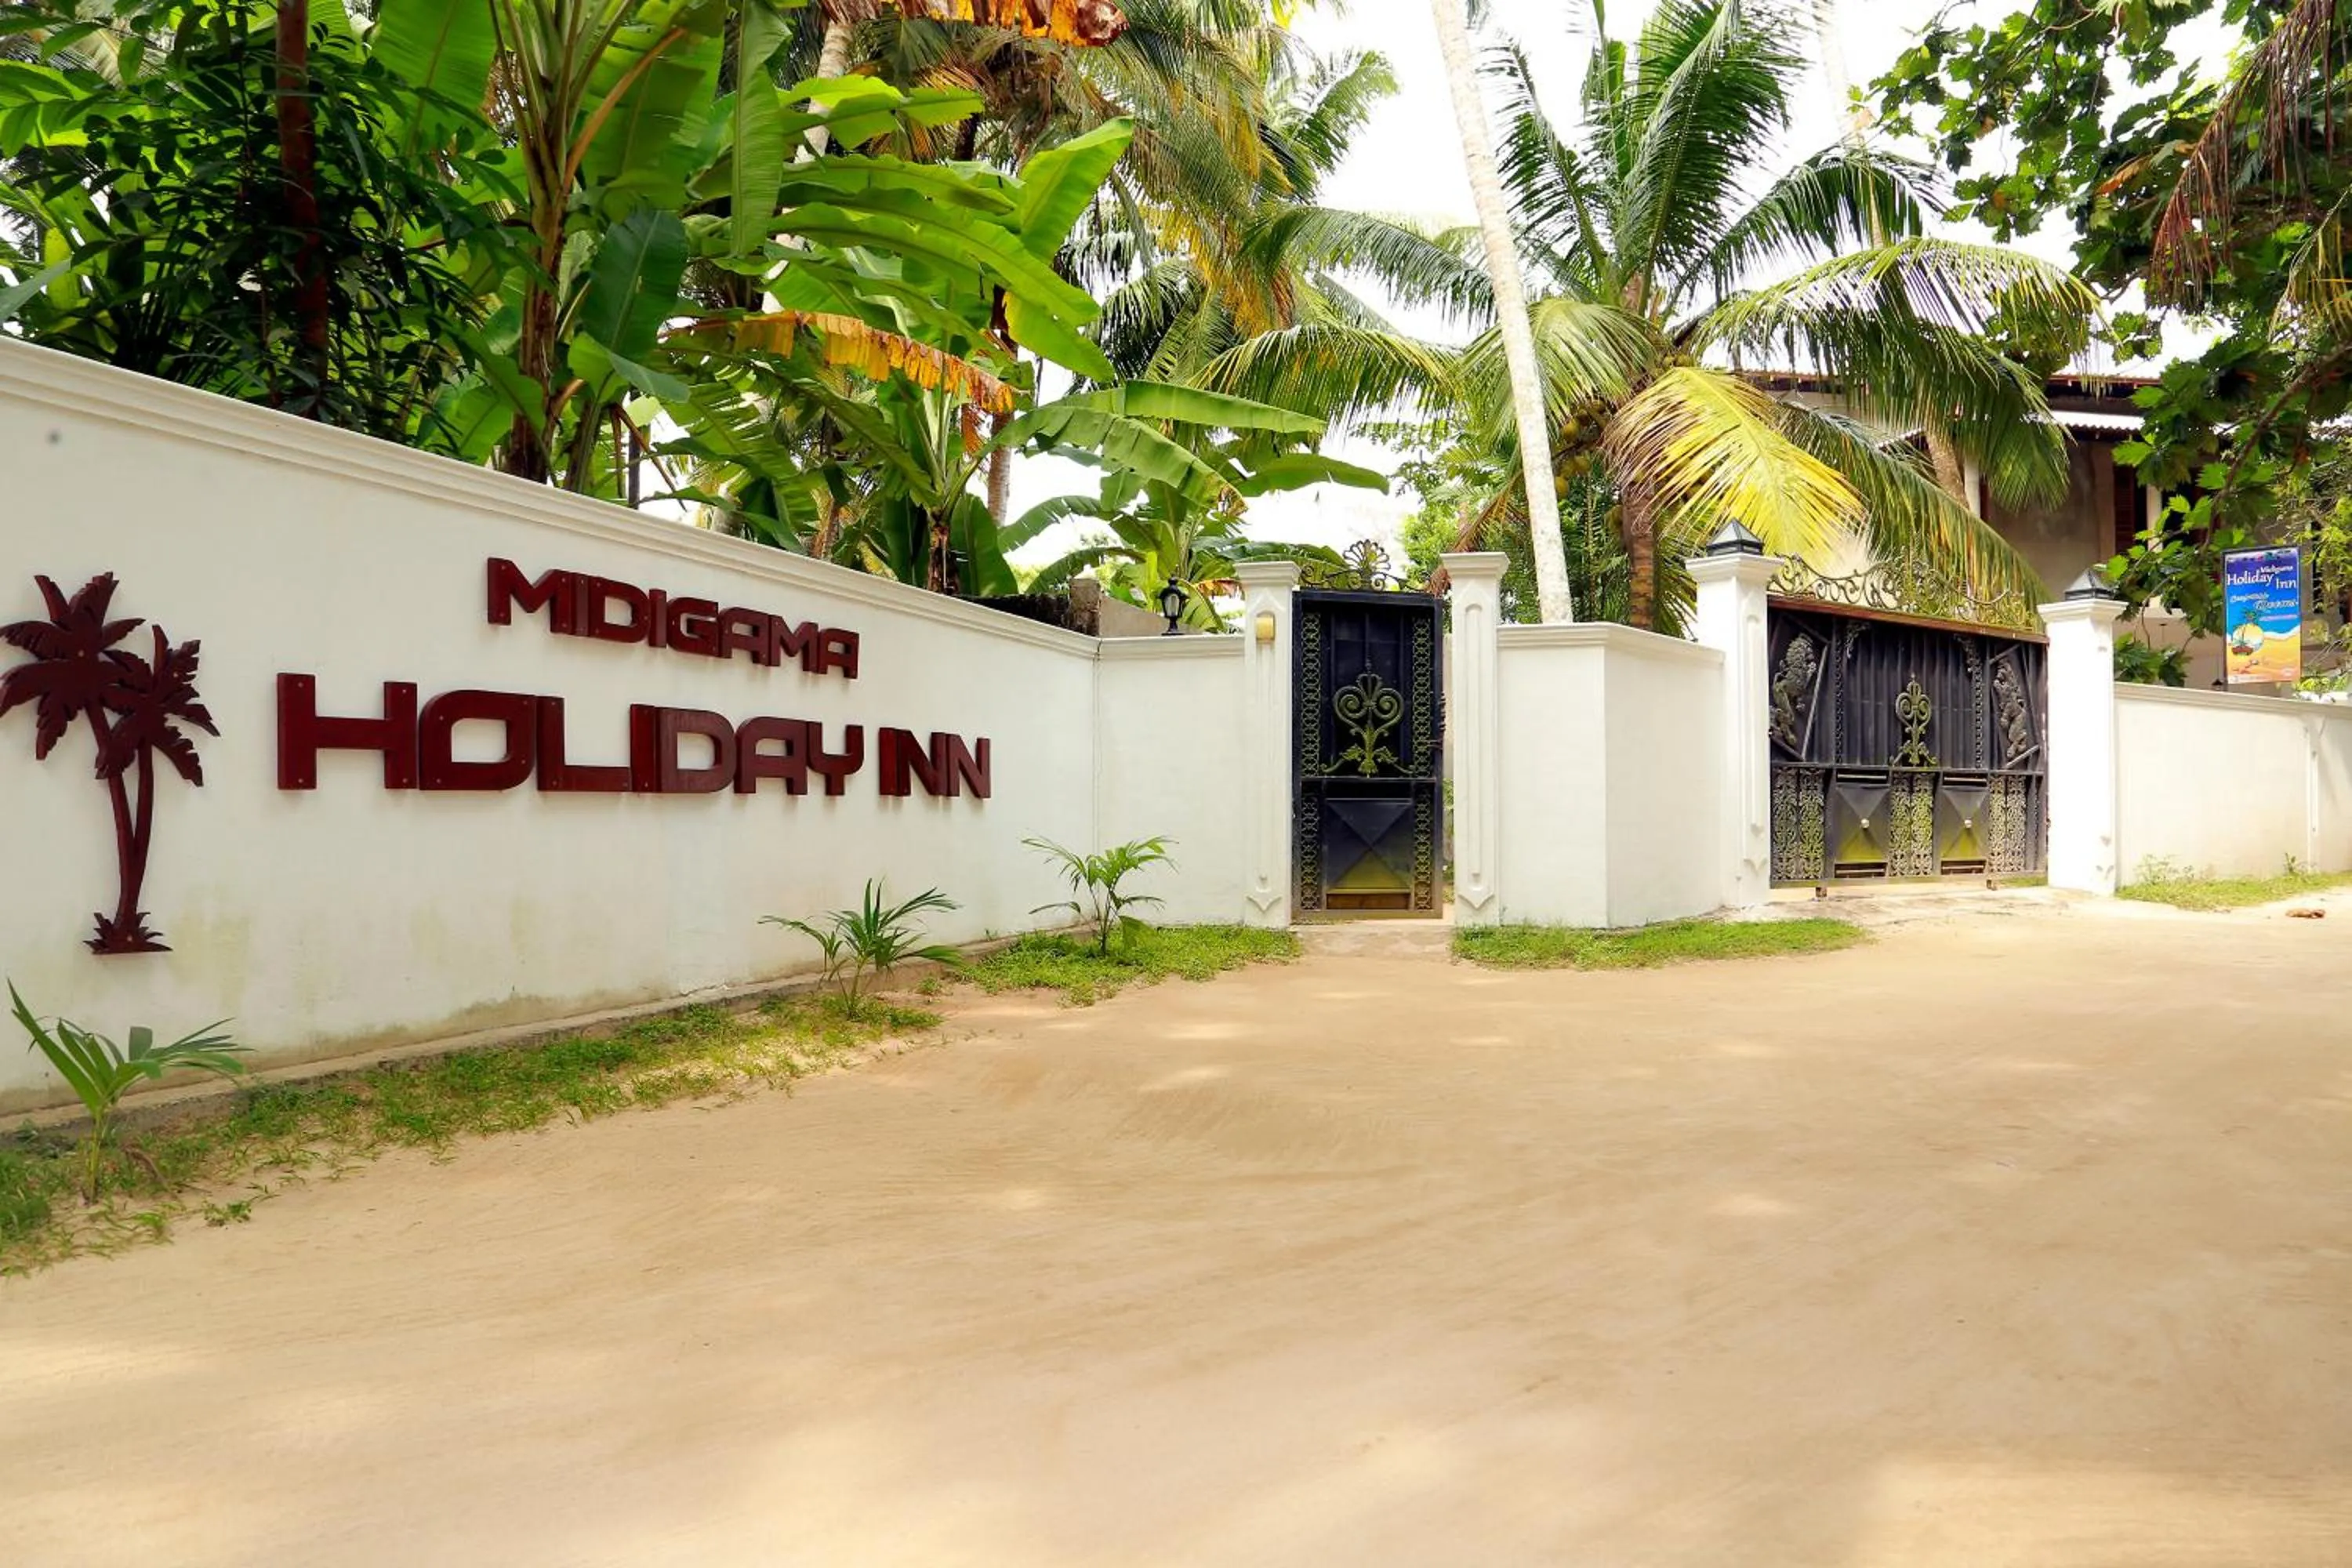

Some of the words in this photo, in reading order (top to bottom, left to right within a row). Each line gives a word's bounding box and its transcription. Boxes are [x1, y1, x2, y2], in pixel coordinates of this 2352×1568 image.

[487, 557, 859, 679] MIDIGAMA
[2227, 570, 2274, 587] Holiday
[2276, 578, 2296, 590] Inn
[277, 673, 864, 795] HOLIDAY
[879, 728, 991, 798] INN
